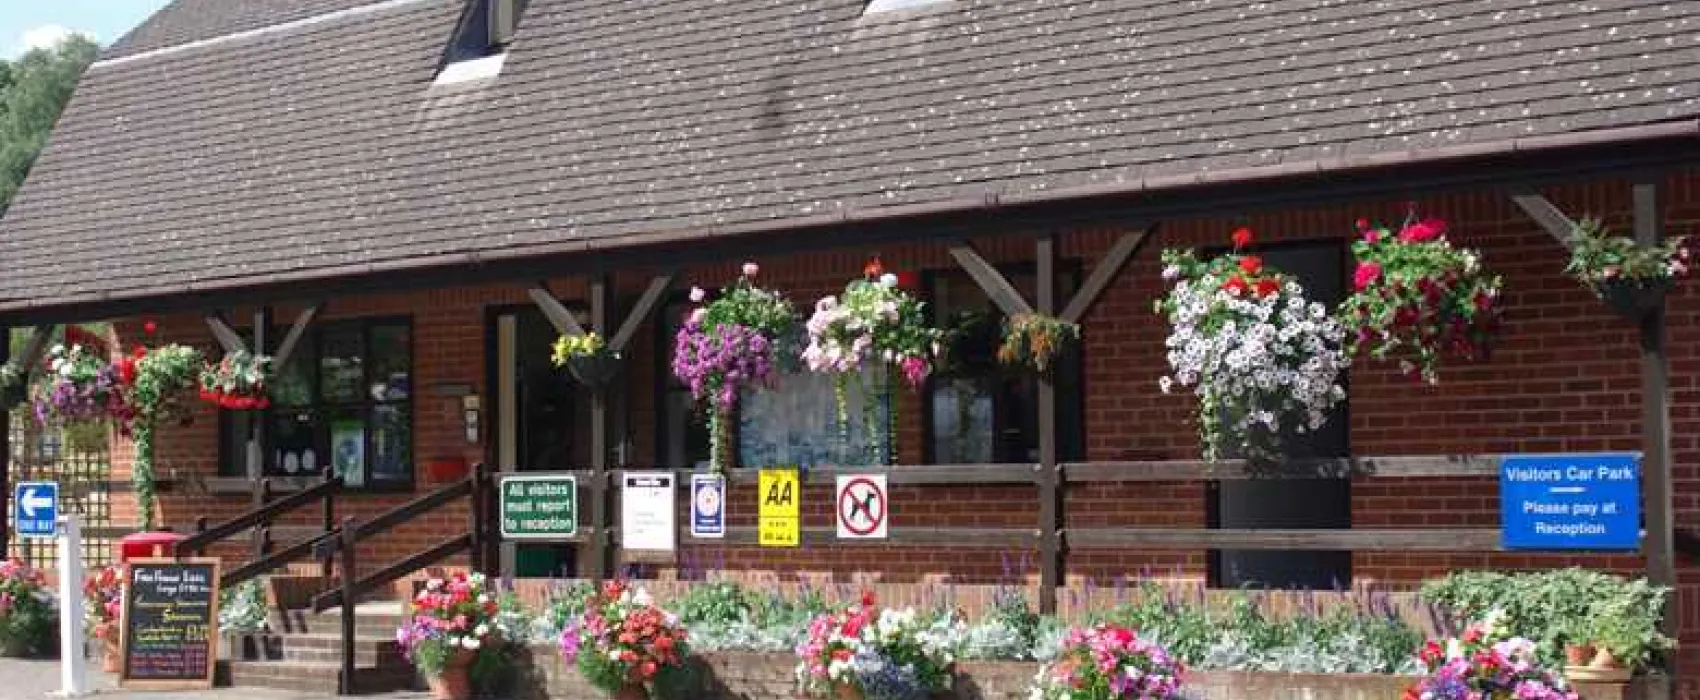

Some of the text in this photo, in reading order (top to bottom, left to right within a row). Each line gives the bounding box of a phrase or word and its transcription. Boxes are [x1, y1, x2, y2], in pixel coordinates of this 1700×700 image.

[1505, 465, 1633, 481] Visitors Car Park
[509, 483, 568, 496] All visitors
[765, 481, 792, 506] AA
[507, 498, 570, 514] must report
[1523, 501, 1616, 517] Please pay at
[505, 515, 572, 532] to reception
[1535, 522, 1606, 538] Reception
